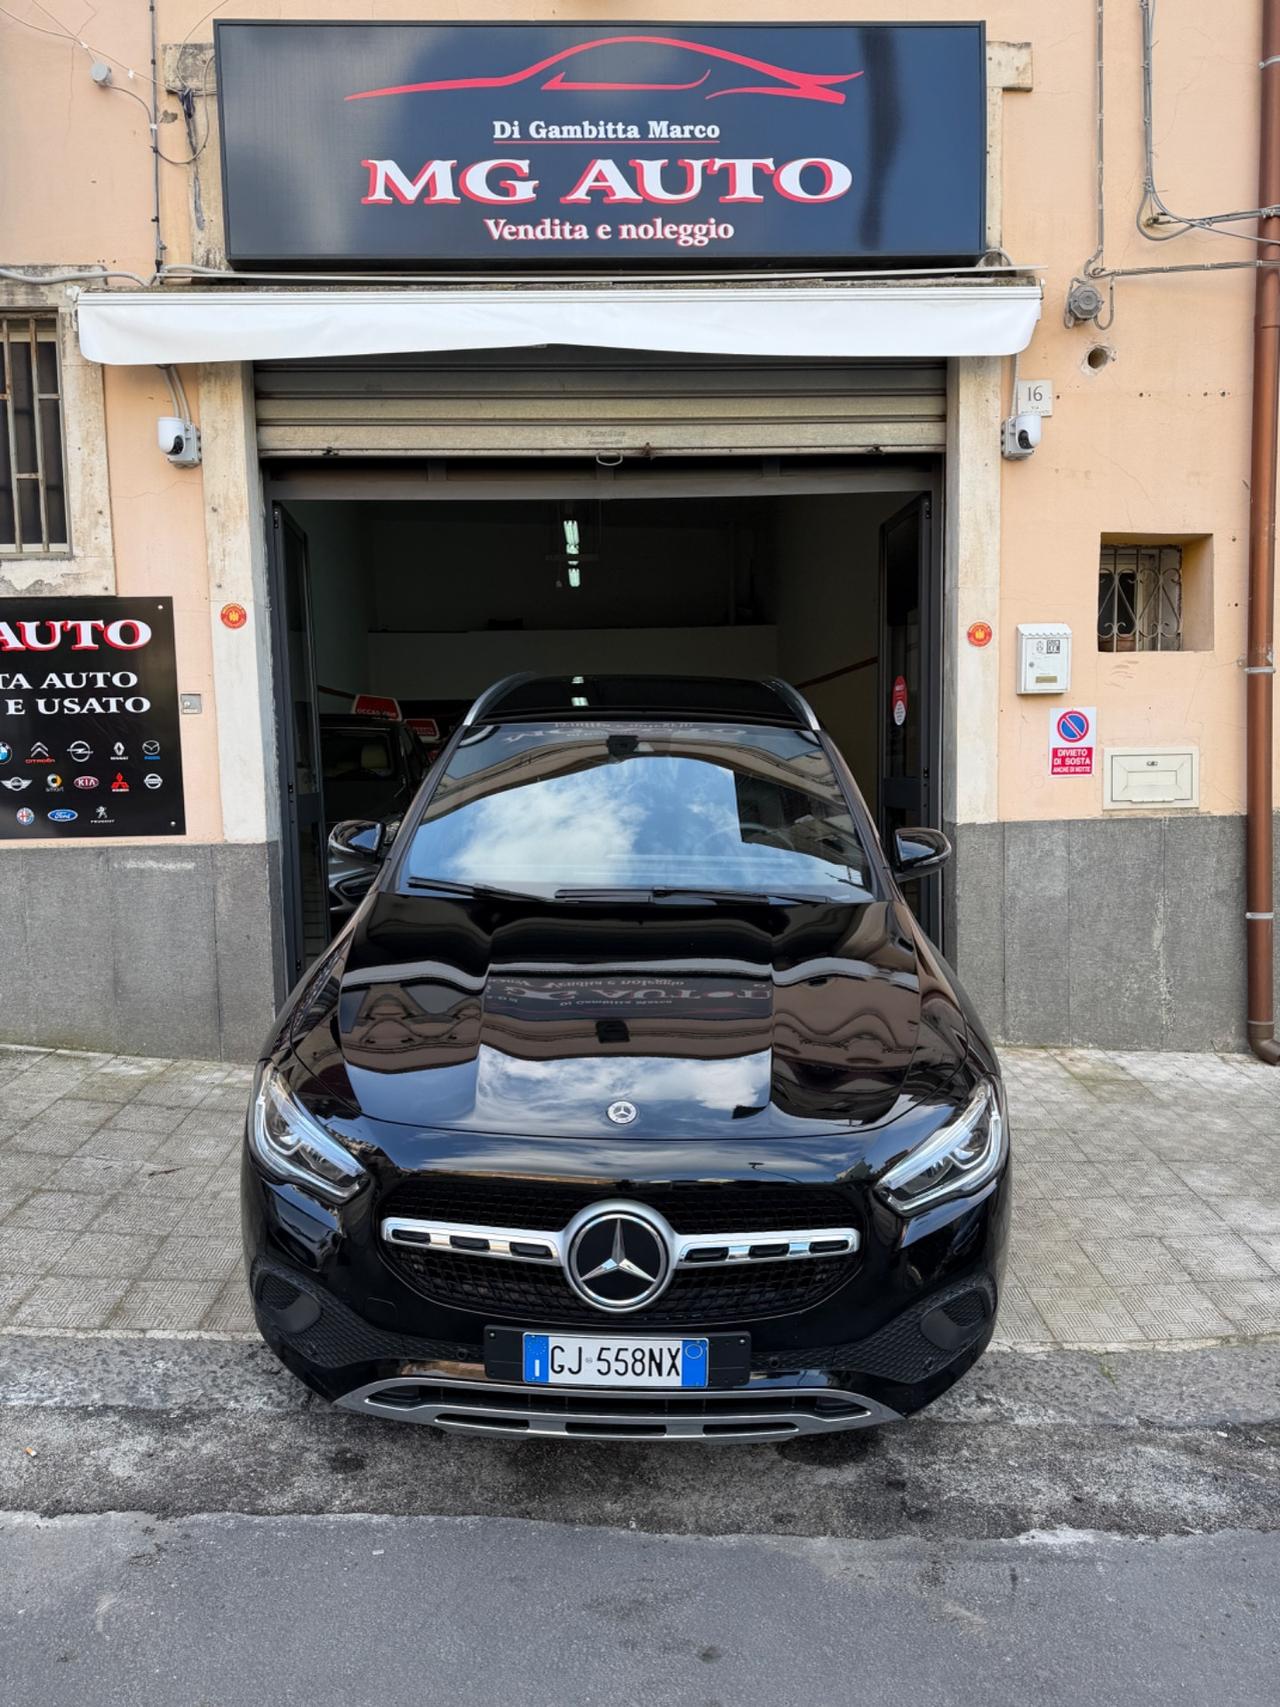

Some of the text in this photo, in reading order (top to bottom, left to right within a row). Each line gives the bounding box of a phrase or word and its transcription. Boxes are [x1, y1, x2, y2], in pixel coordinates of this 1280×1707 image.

[493, 120, 721, 139] Di Gambitta Marco
[361, 157, 853, 204] MG AUTO
[484, 217, 735, 247] Vendita e noleggio
[1028, 384, 1043, 401] 16
[0, 619, 152, 651] AUTO
[40, 671, 138, 690] AUTO
[7, 697, 151, 715] E USATO
[1053, 757, 1091, 766] DI SOSTA
[1057, 749, 1088, 757] DIVIETO
